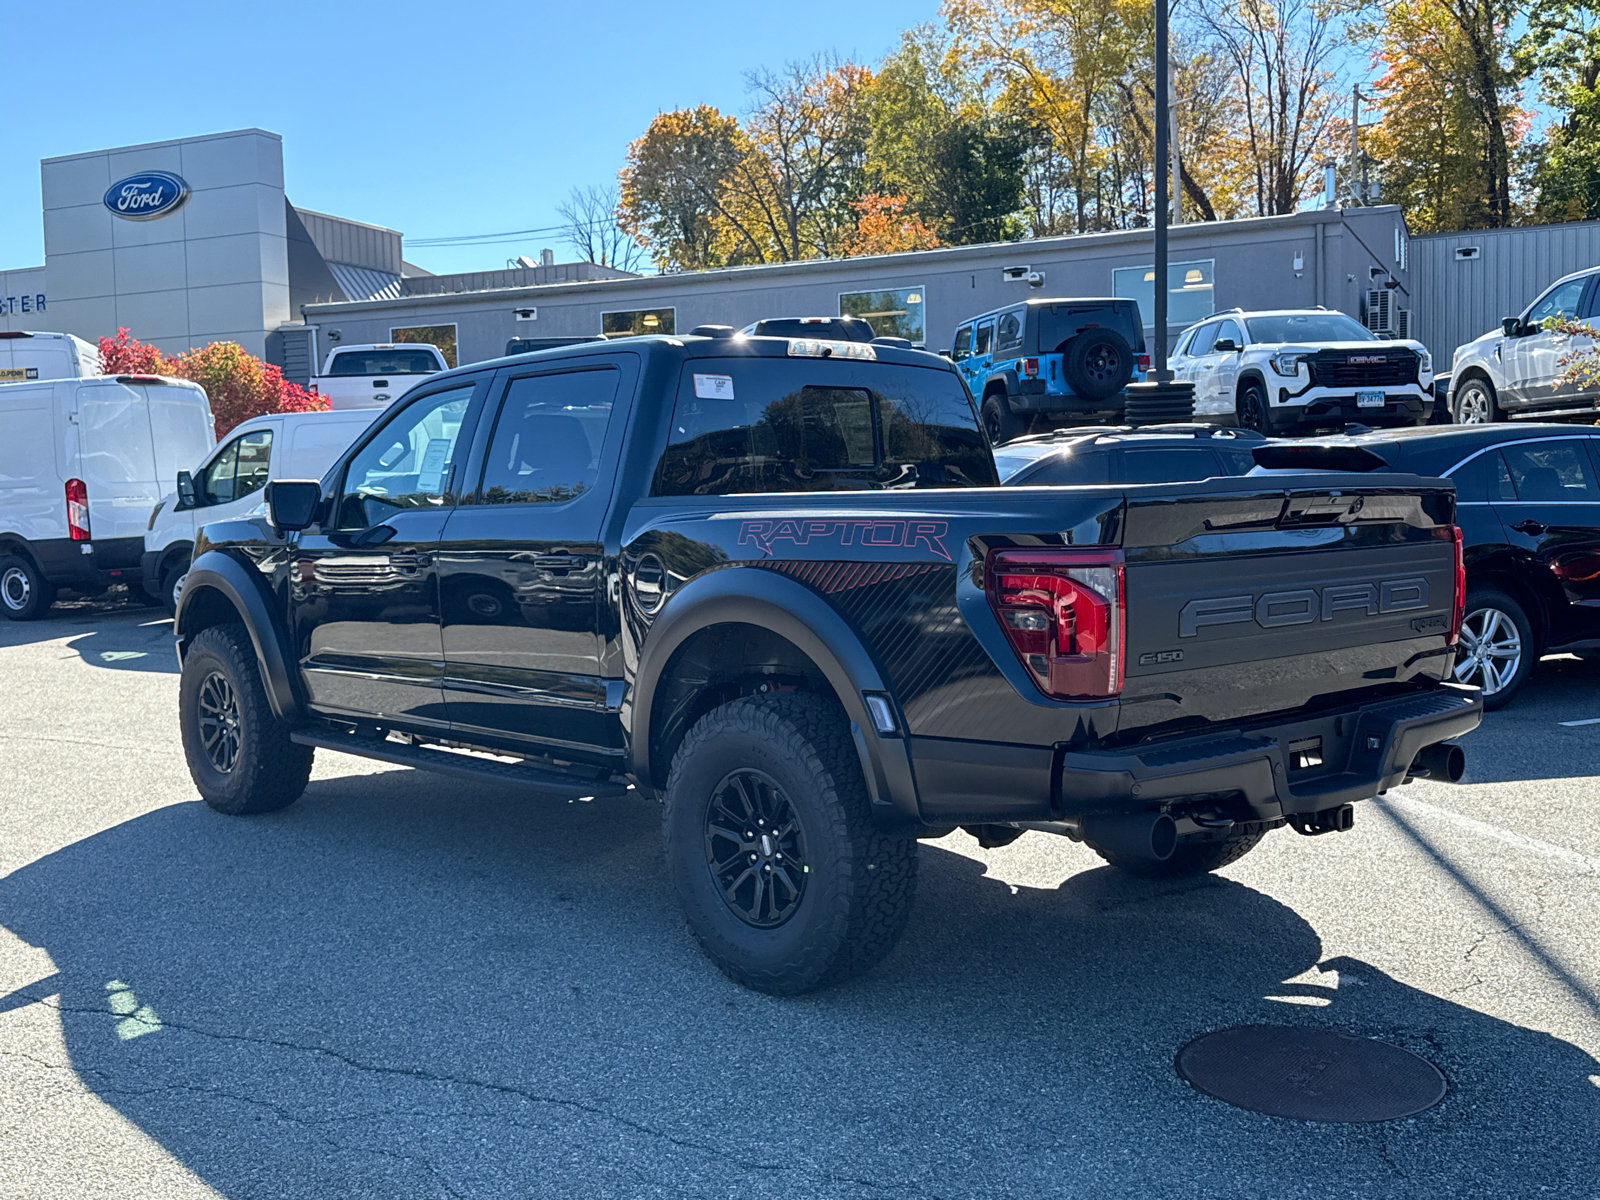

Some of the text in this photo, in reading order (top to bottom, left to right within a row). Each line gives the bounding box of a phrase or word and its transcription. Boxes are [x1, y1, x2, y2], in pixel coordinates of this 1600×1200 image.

[117, 182, 164, 211] Ford
[1350, 355, 1387, 365] GMC
[737, 520, 952, 562] RAPTOR
[1178, 577, 1430, 639] FORD
[1139, 649, 1184, 666] F-150
